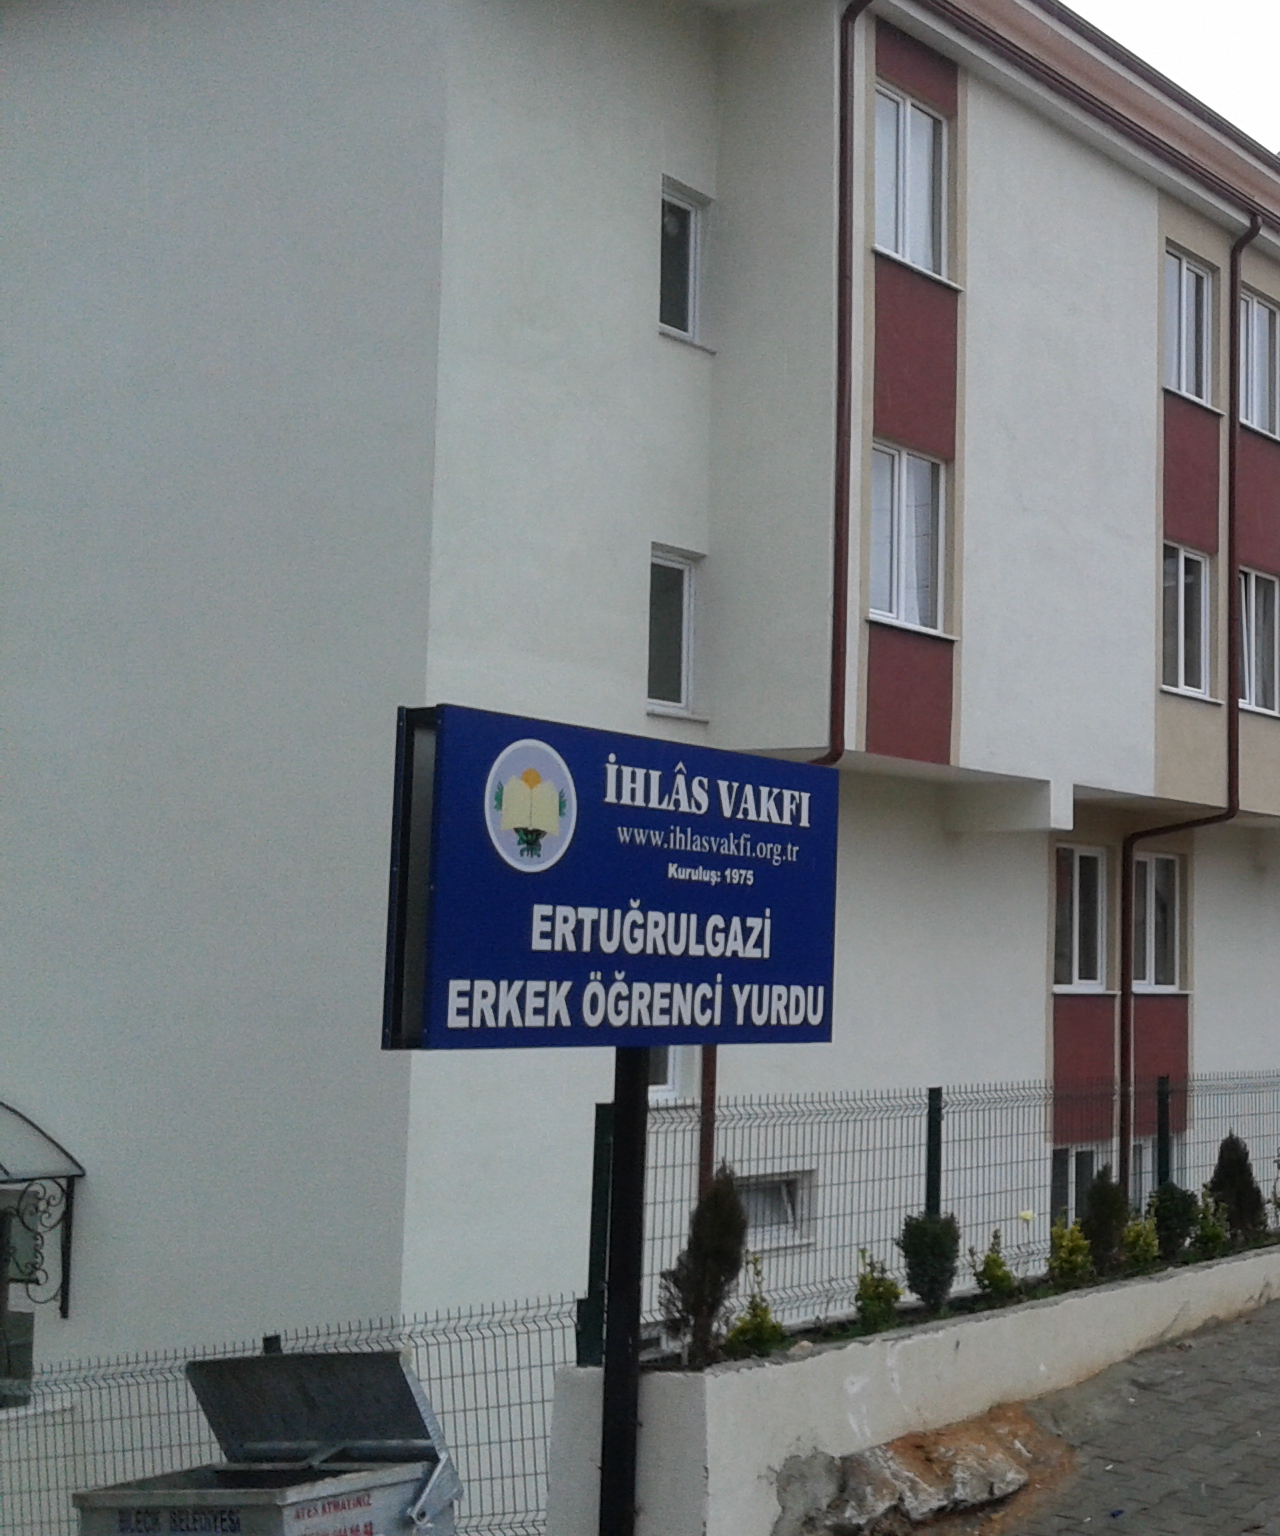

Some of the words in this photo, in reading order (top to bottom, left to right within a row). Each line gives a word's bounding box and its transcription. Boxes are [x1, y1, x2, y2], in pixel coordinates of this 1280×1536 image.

[604, 753, 709, 815] İHLÂS
[716, 779, 811, 828] VAKFI
[616, 825, 800, 866] www.ihlasvakfi.org.tr
[667, 862, 721, 886] Kuruluş:
[724, 867, 755, 886] 1975
[531, 898, 771, 959] ERTUĞRULGAZİ
[447, 979, 573, 1029] ERKEK
[582, 969, 723, 1028] ÖĞRENCİ
[732, 983, 825, 1027] YURDU
